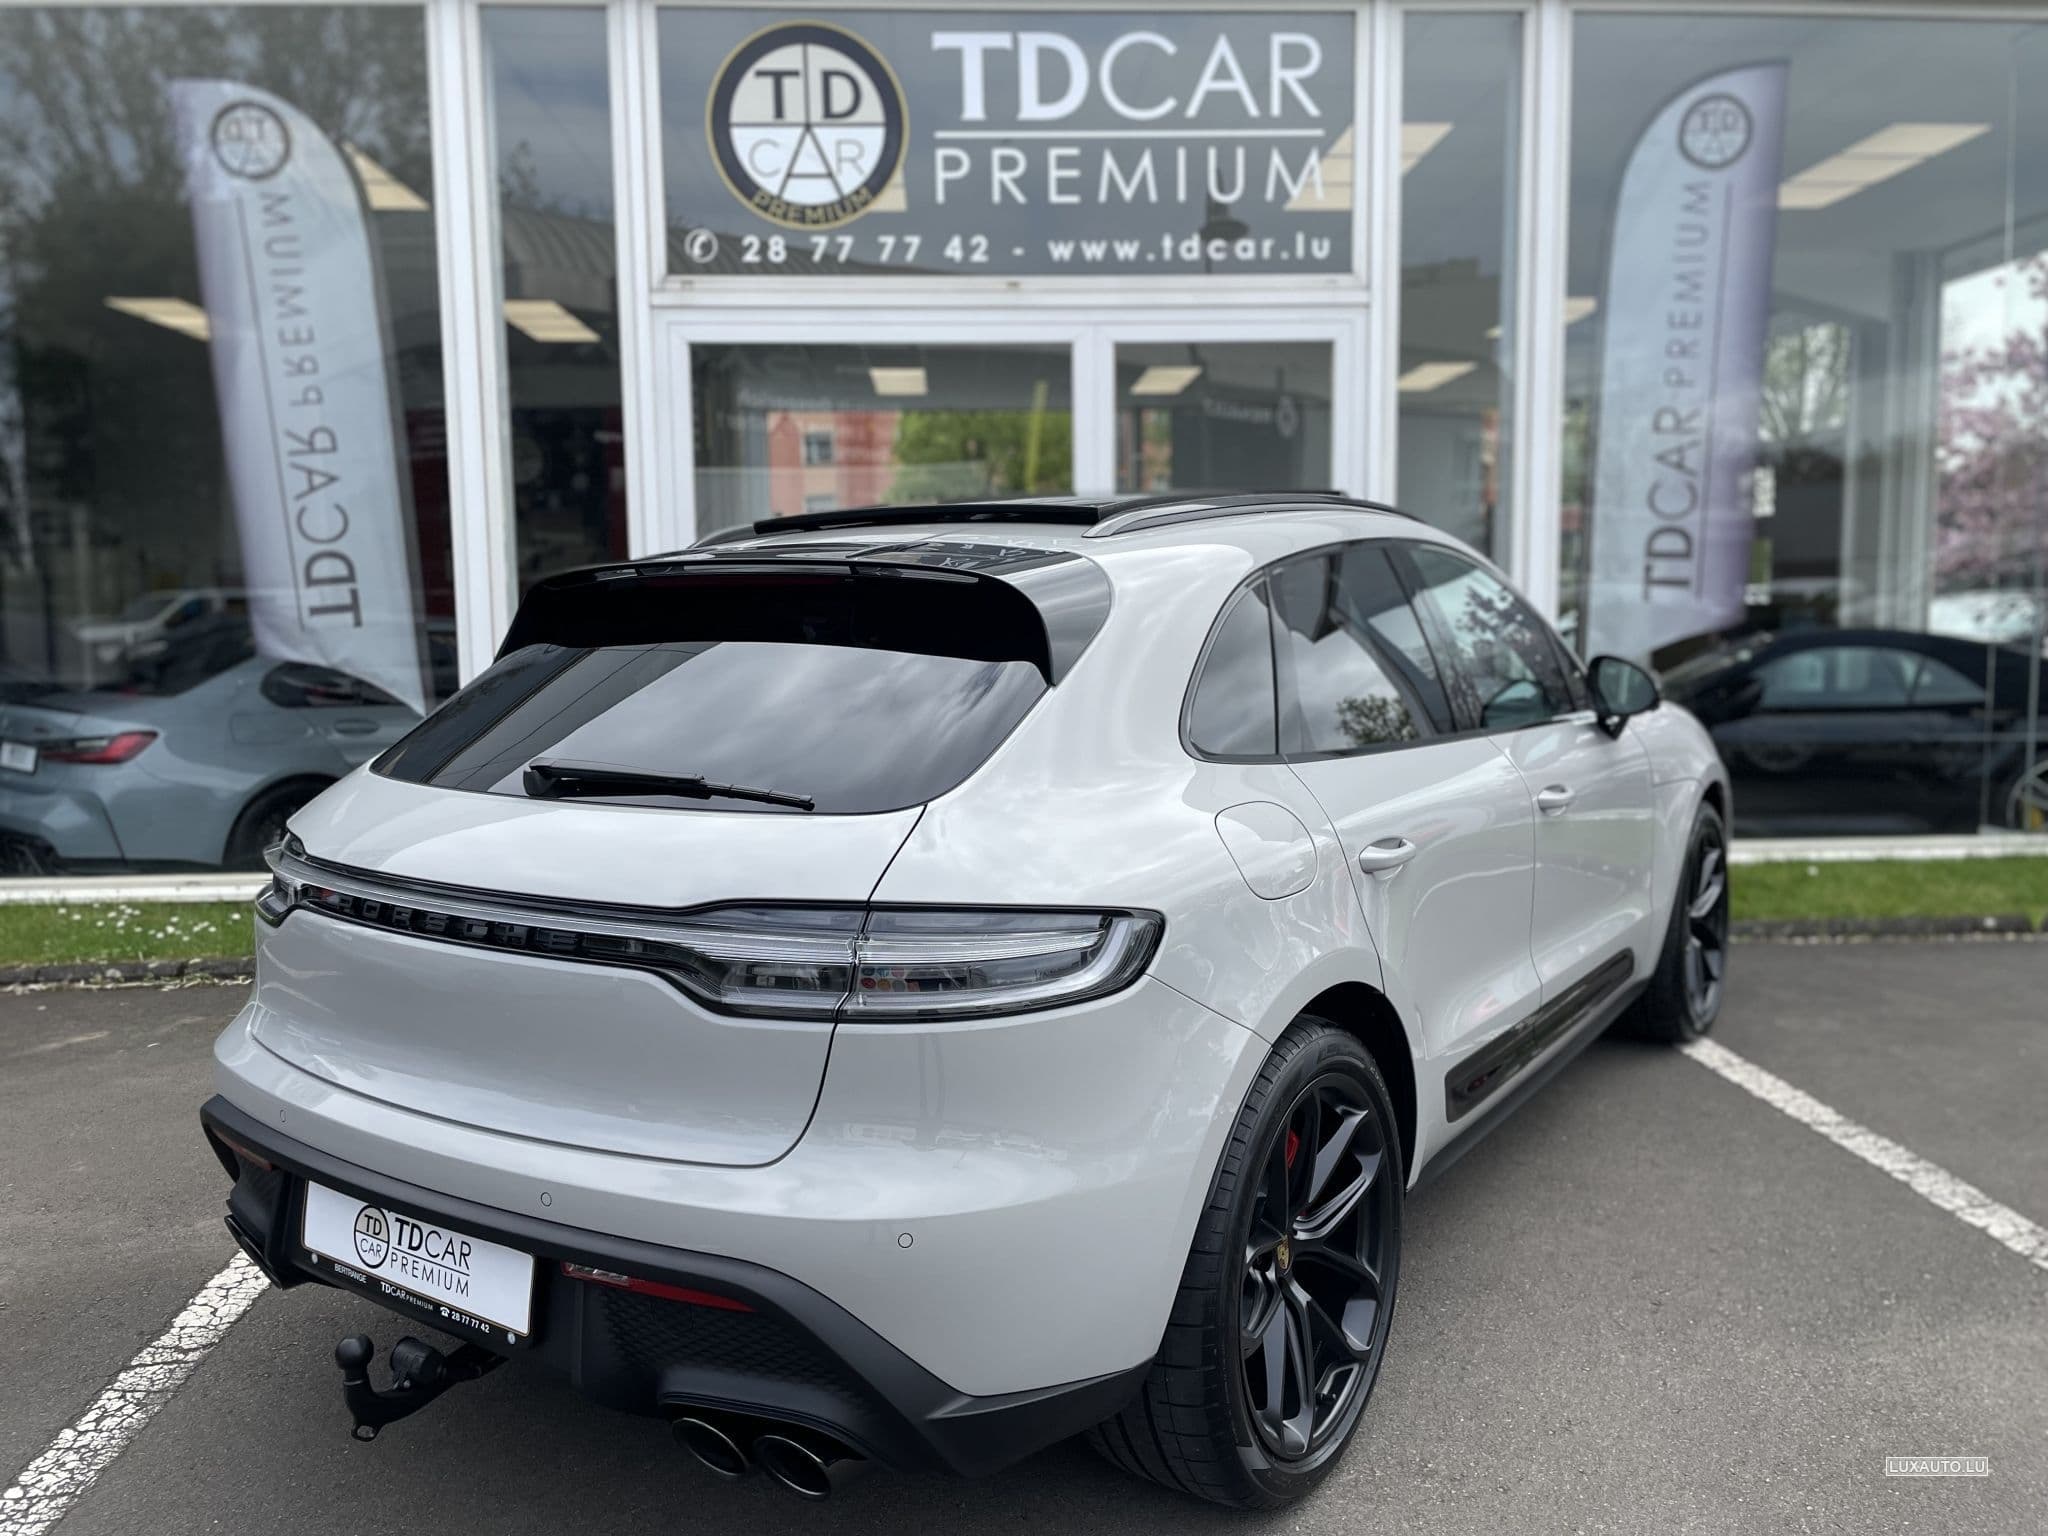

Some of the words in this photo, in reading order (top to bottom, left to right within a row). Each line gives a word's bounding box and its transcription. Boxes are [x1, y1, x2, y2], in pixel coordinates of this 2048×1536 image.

[932, 32, 1323, 120] TDCAR
[936, 147, 1326, 204] PREMIUM
[752, 184, 873, 225] PREMIUM
[741, 235, 788, 263] 28
[810, 235, 854, 263] 77
[877, 235, 922, 263] 77
[943, 235, 990, 263] 42
[1048, 231, 1331, 262] www.tdcar.lu
[1663, 180, 1714, 389] PREMIUM
[1642, 406, 1700, 601] TDCAR
[360, 1238, 382, 1259] CAR
[363, 1213, 383, 1236] TD
[394, 1216, 473, 1270] TDCAR
[334, 1263, 368, 1285] BERTRANGE
[451, 1311, 461, 1322] 28
[461, 1314, 470, 1325] 77
[471, 1318, 480, 1329] 77
[480, 1322, 490, 1334] 42
[390, 1251, 470, 1298] PREMIUM
